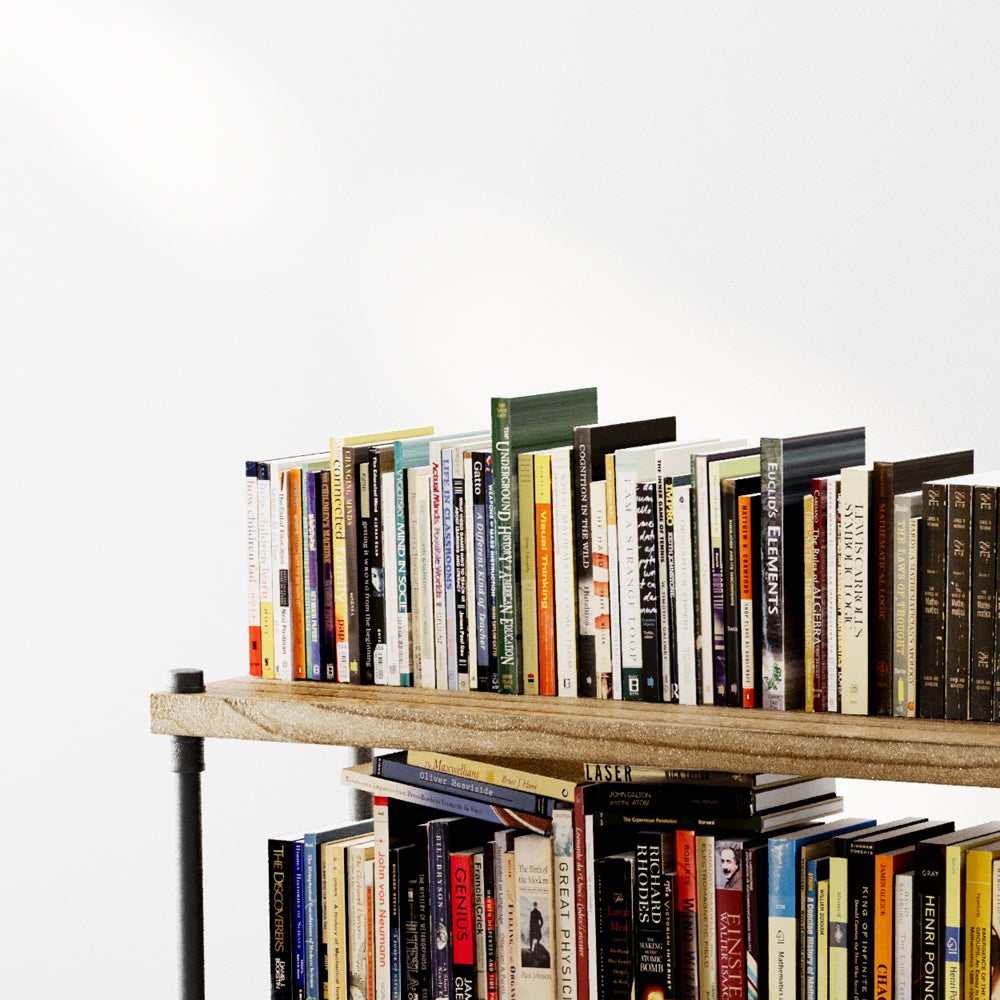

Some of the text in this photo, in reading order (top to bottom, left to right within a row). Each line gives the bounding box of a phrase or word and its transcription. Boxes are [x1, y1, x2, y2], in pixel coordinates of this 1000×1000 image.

[474, 461, 484, 495] Gatto
[580, 444, 588, 501] COGNITION
[581, 504, 588, 515] IN
[666, 484, 674, 526] IMPRO
[476, 524, 485, 566] Different
[539, 511, 550, 609] Visual Thinking
[478, 570, 486, 594] Kind
[768, 526, 780, 615] ELEMENTS
[478, 598, 486, 609] of
[478, 612, 488, 650] Teacher
[419, 772, 494, 796] Oliver Heaviside
[434, 759, 480, 779] Maxwellians
[586, 764, 632, 782] LASER
[274, 846, 284, 952] THE DISCOVERERS
[456, 868, 468, 941] GENIUS
[559, 862, 569, 920] GREAT
[637, 846, 649, 923] RHODES
[650, 846, 660, 924] RICHARD
[378, 852, 387, 967] John von Neumann
[925, 895, 935, 947] HENRI
[720, 912, 729, 960] WALTER
